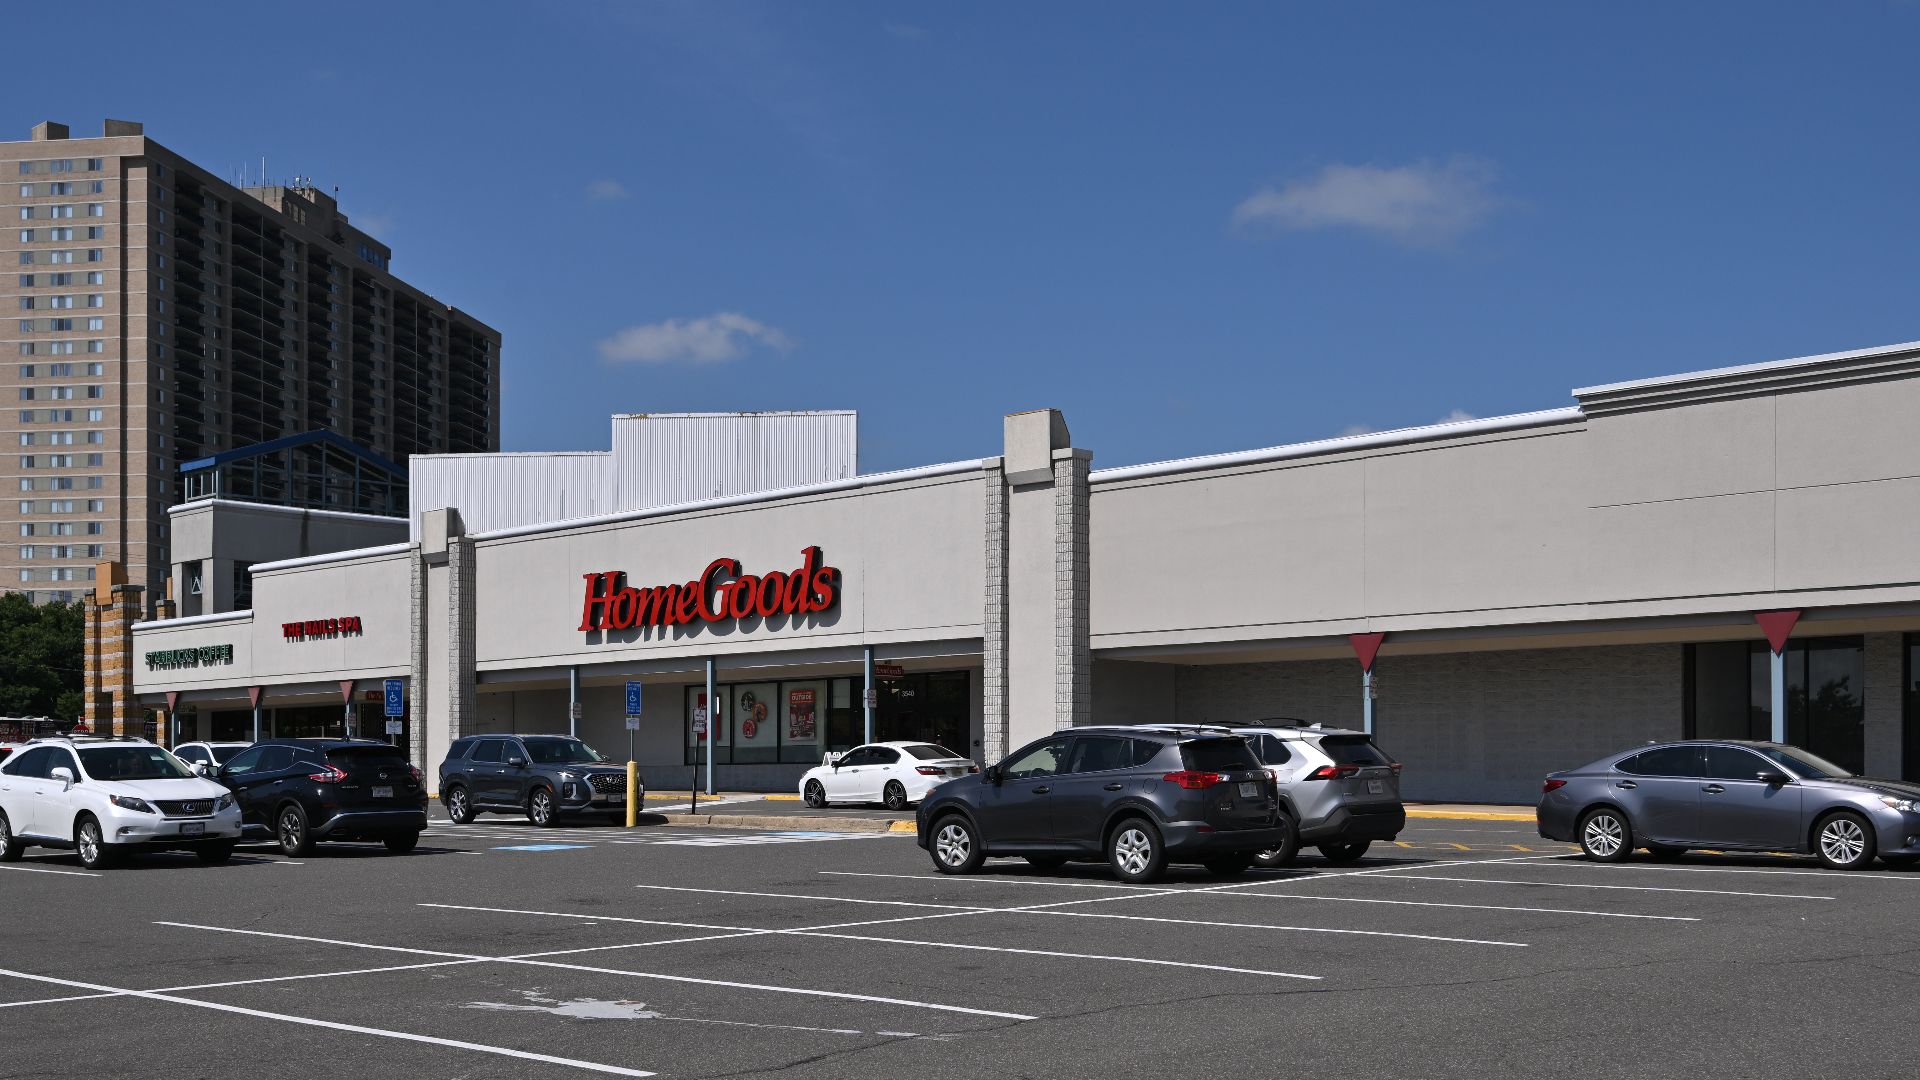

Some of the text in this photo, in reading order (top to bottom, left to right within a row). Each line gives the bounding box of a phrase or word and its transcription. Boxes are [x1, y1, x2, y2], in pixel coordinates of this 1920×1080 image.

[578, 546, 836, 632] HomeGoods
[282, 615, 361, 638] THE NAILS SPA
[145, 644, 232, 667] STARBUCKS COFFEE
